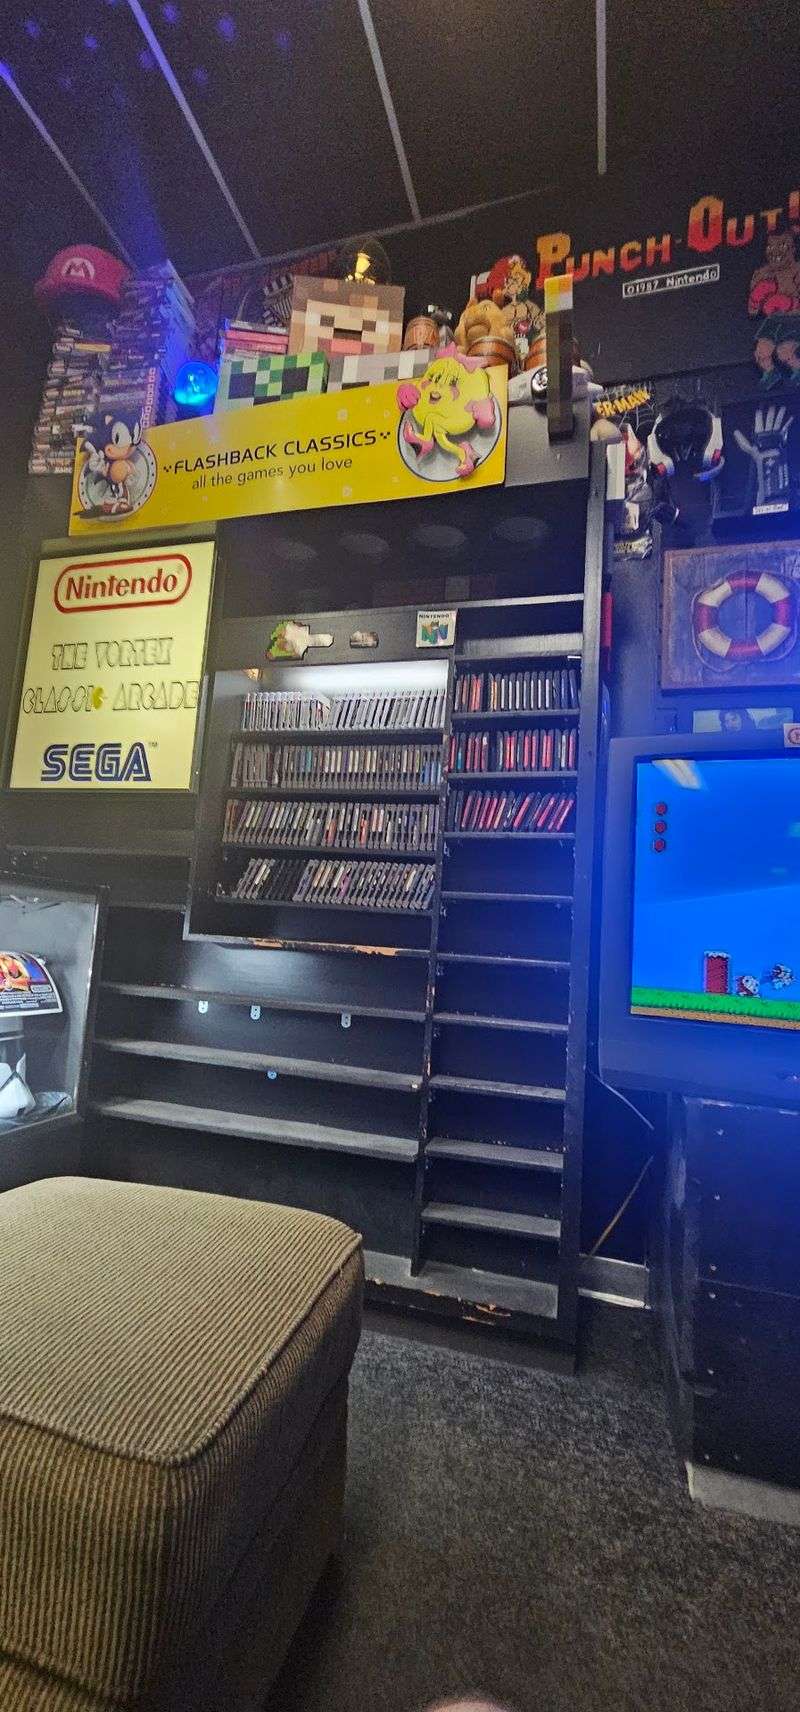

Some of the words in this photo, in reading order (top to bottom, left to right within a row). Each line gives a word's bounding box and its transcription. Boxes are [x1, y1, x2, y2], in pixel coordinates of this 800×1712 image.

[666, 269, 717, 288] Nintendo
[174, 443, 276, 475] FLASHBACK
[283, 429, 377, 455] CLASSICS
[191, 475, 207, 490] all
[210, 472, 235, 488] the
[237, 466, 284, 486] games
[288, 461, 316, 479] you
[321, 455, 353, 474] love
[65, 568, 178, 601] Nintendo
[51, 643, 88, 671] THE
[95, 637, 175, 671] VORTEX
[22, 684, 106, 714] CLASSIC
[112, 680, 200, 712] ARCADE
[40, 742, 152, 782] SEGA
